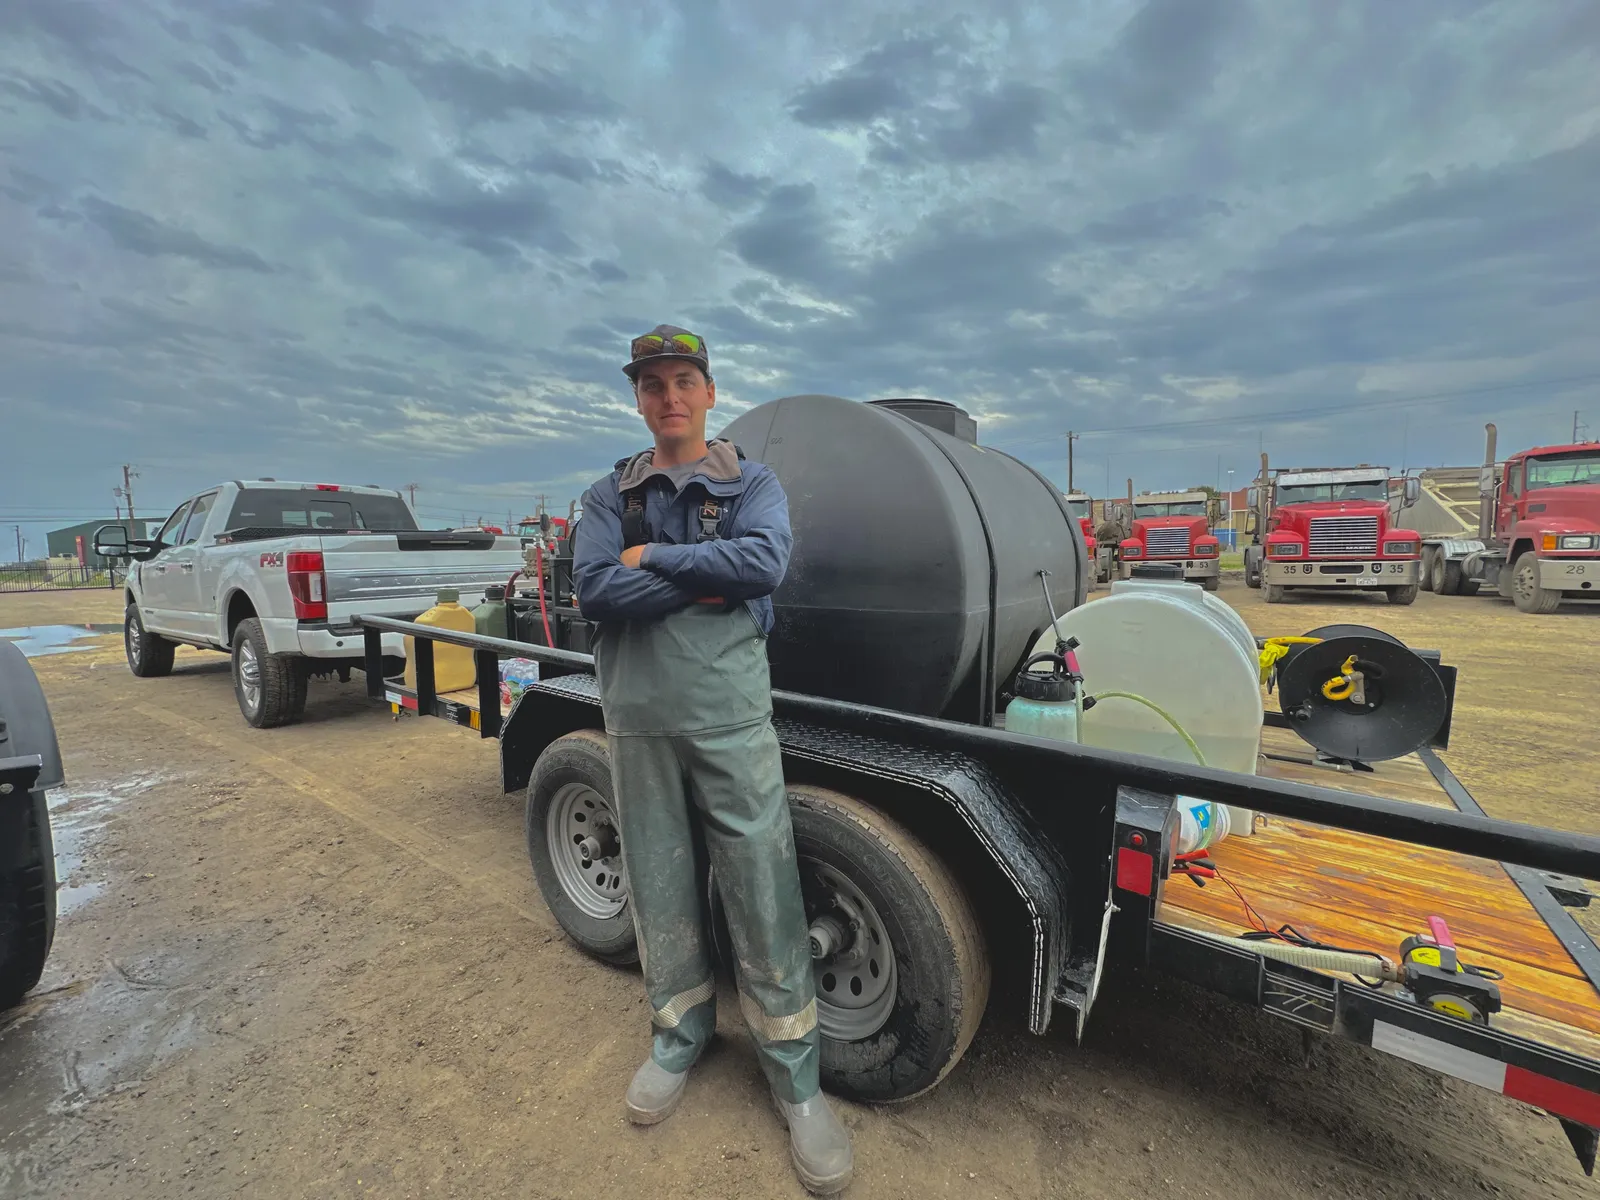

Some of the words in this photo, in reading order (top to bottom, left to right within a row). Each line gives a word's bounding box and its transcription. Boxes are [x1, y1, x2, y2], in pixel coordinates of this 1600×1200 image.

[1284, 565, 1296, 574] 35
[1390, 564, 1404, 574] 35
[1566, 565, 1585, 574] 28
